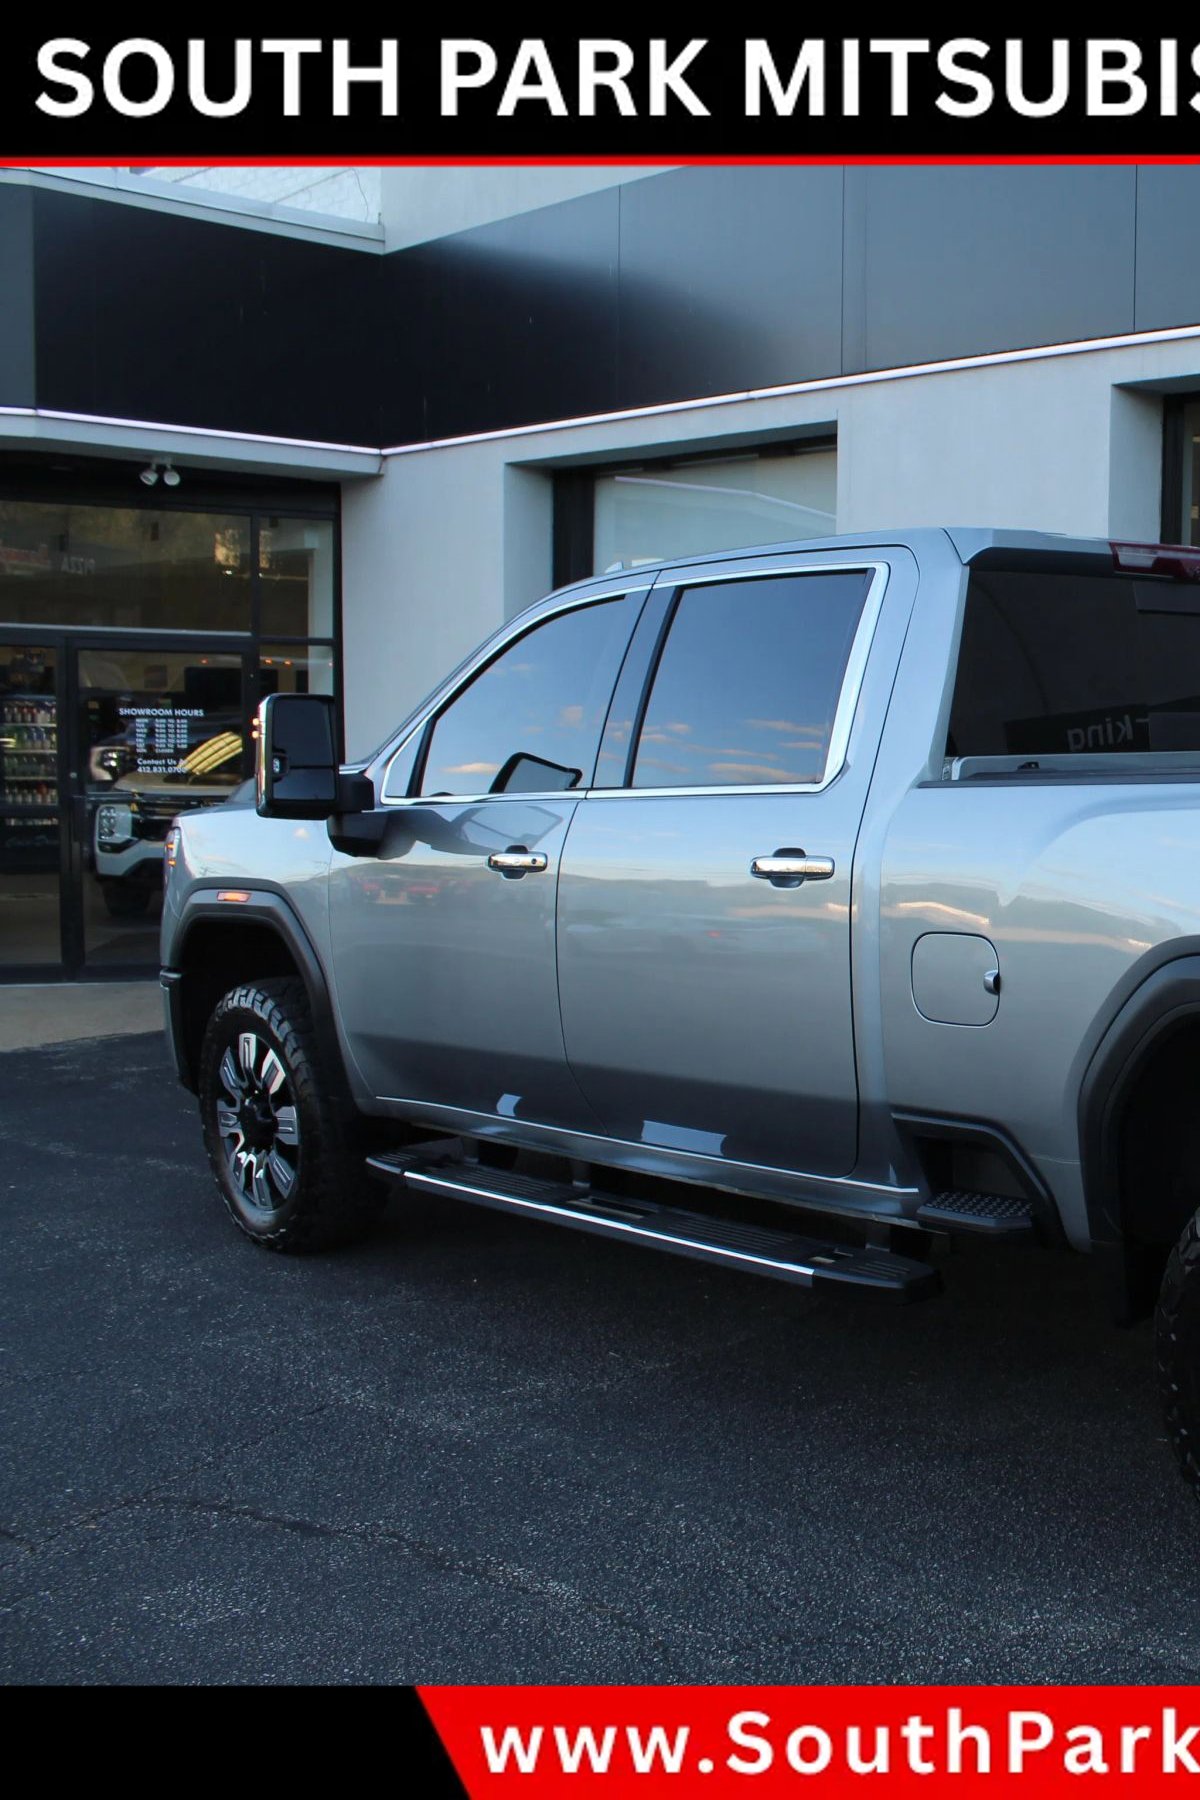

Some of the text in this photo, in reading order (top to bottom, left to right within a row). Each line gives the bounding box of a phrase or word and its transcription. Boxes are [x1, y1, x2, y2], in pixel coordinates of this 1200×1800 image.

[119, 707, 205, 717] SHOWROOM HOURS
[137, 758, 166, 766] Contact
[168, 758, 177, 766] Us
